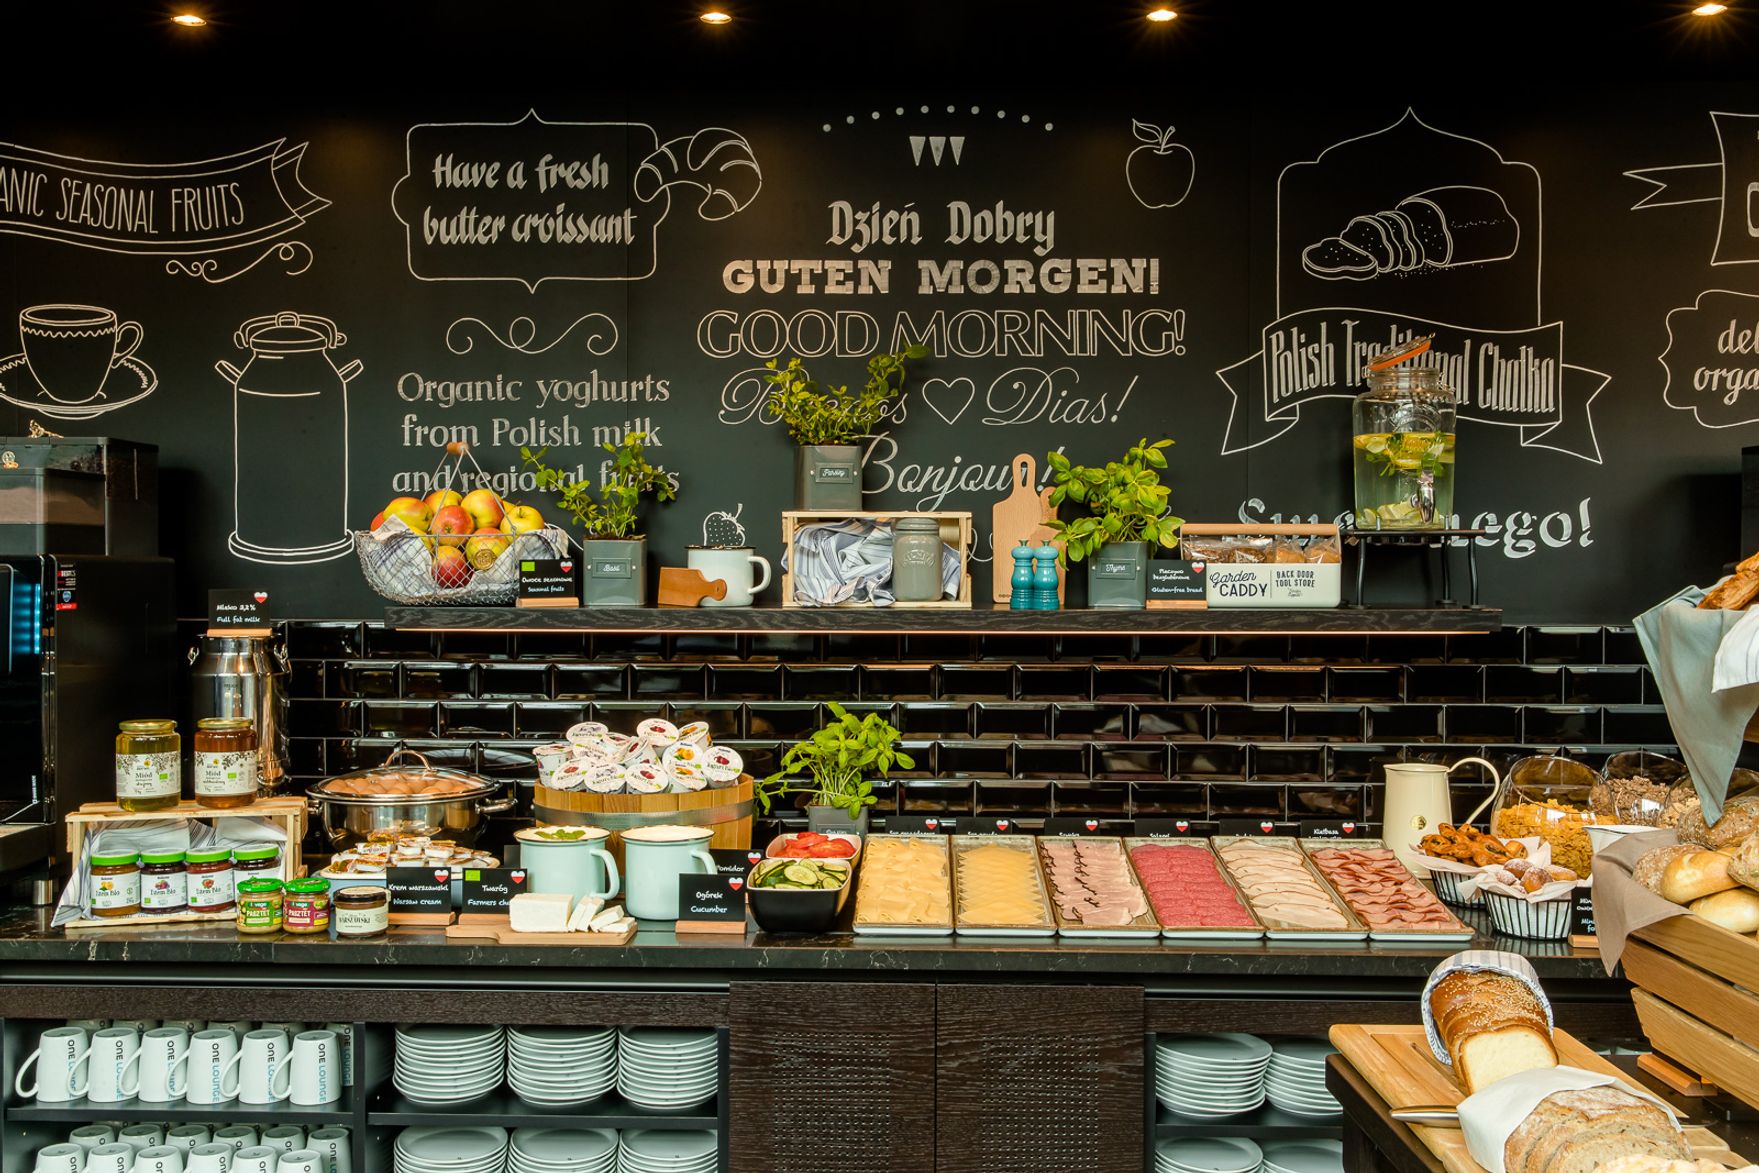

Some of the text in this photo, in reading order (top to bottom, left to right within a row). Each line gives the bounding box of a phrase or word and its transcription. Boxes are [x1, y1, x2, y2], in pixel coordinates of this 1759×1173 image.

[432, 153, 609, 194] Have a fresh
[56, 177, 159, 234] SEASONAL
[172, 182, 244, 233] FRUITS
[423, 203, 638, 245] butter croissant
[825, 200, 1056, 256] Dzień Dobry
[722, 259, 1160, 295] GUTEN MORGEN!
[696, 309, 1187, 358] GOOD MORNING!
[1269, 321, 1335, 403] Polish
[397, 369, 670, 408] Organic yoghurts
[982, 367, 1139, 426] Dias!
[401, 414, 480, 447] from
[491, 415, 582, 447] Polish
[392, 465, 451, 493] and
[1209, 570, 1257, 588] Garden
[1219, 583, 1268, 597] CADDY
[1276, 570, 1314, 579] BACK DOOR
[1294, 579, 1316, 587] STORE
[388, 883, 407, 891] Krem
[482, 884, 508, 894] Twaróg
[695, 891, 723, 900] Ogórek
[690, 905, 728, 913] Cucumber
